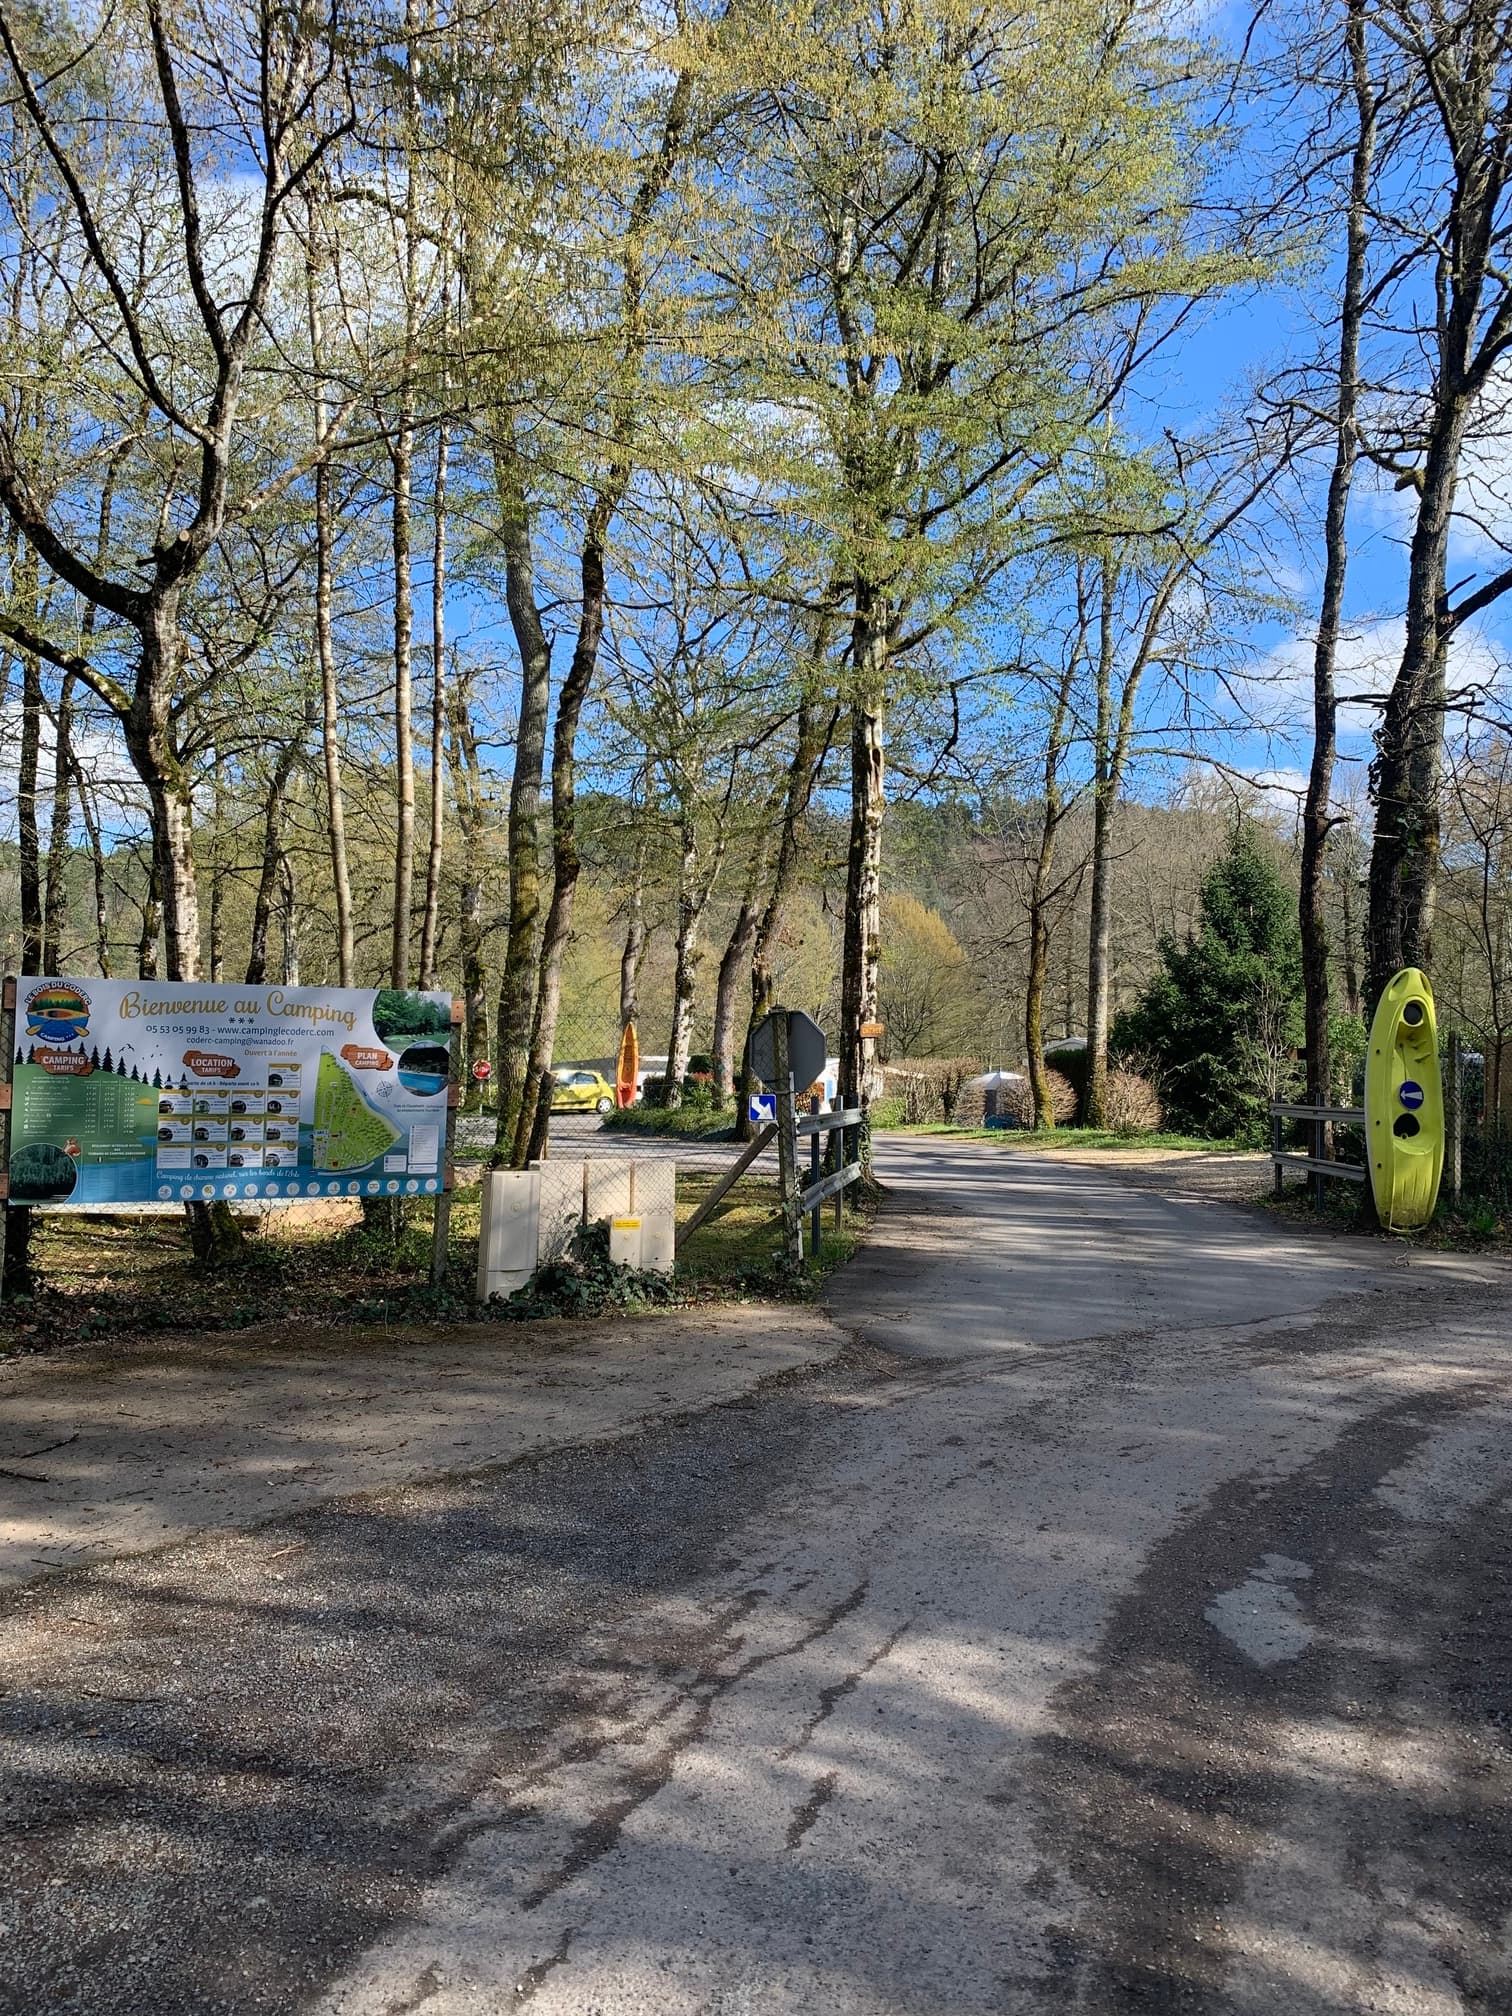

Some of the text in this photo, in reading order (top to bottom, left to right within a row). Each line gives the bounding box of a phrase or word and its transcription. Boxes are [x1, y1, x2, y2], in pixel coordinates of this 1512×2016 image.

[25, 993, 35, 1004] LE
[33, 983, 50, 996] BOIS
[64, 982, 92, 1005] CODERC
[119, 990, 356, 1031] Bienvenue au Camping
[160, 1026, 170, 1034] 53
[172, 1026, 184, 1034] 05
[186, 1026, 197, 1035] 99
[199, 1025, 210, 1034] 83
[217, 1026, 335, 1037] www.campinglecoderc.com
[186, 1037, 294, 1046] coderc-camping@wanadoo.fr
[42, 1055, 85, 1065] CAMPING
[357, 1052, 378, 1060] PLAN
[191, 1058, 233, 1067] LOCATION
[156, 1170, 183, 1182] Camping
